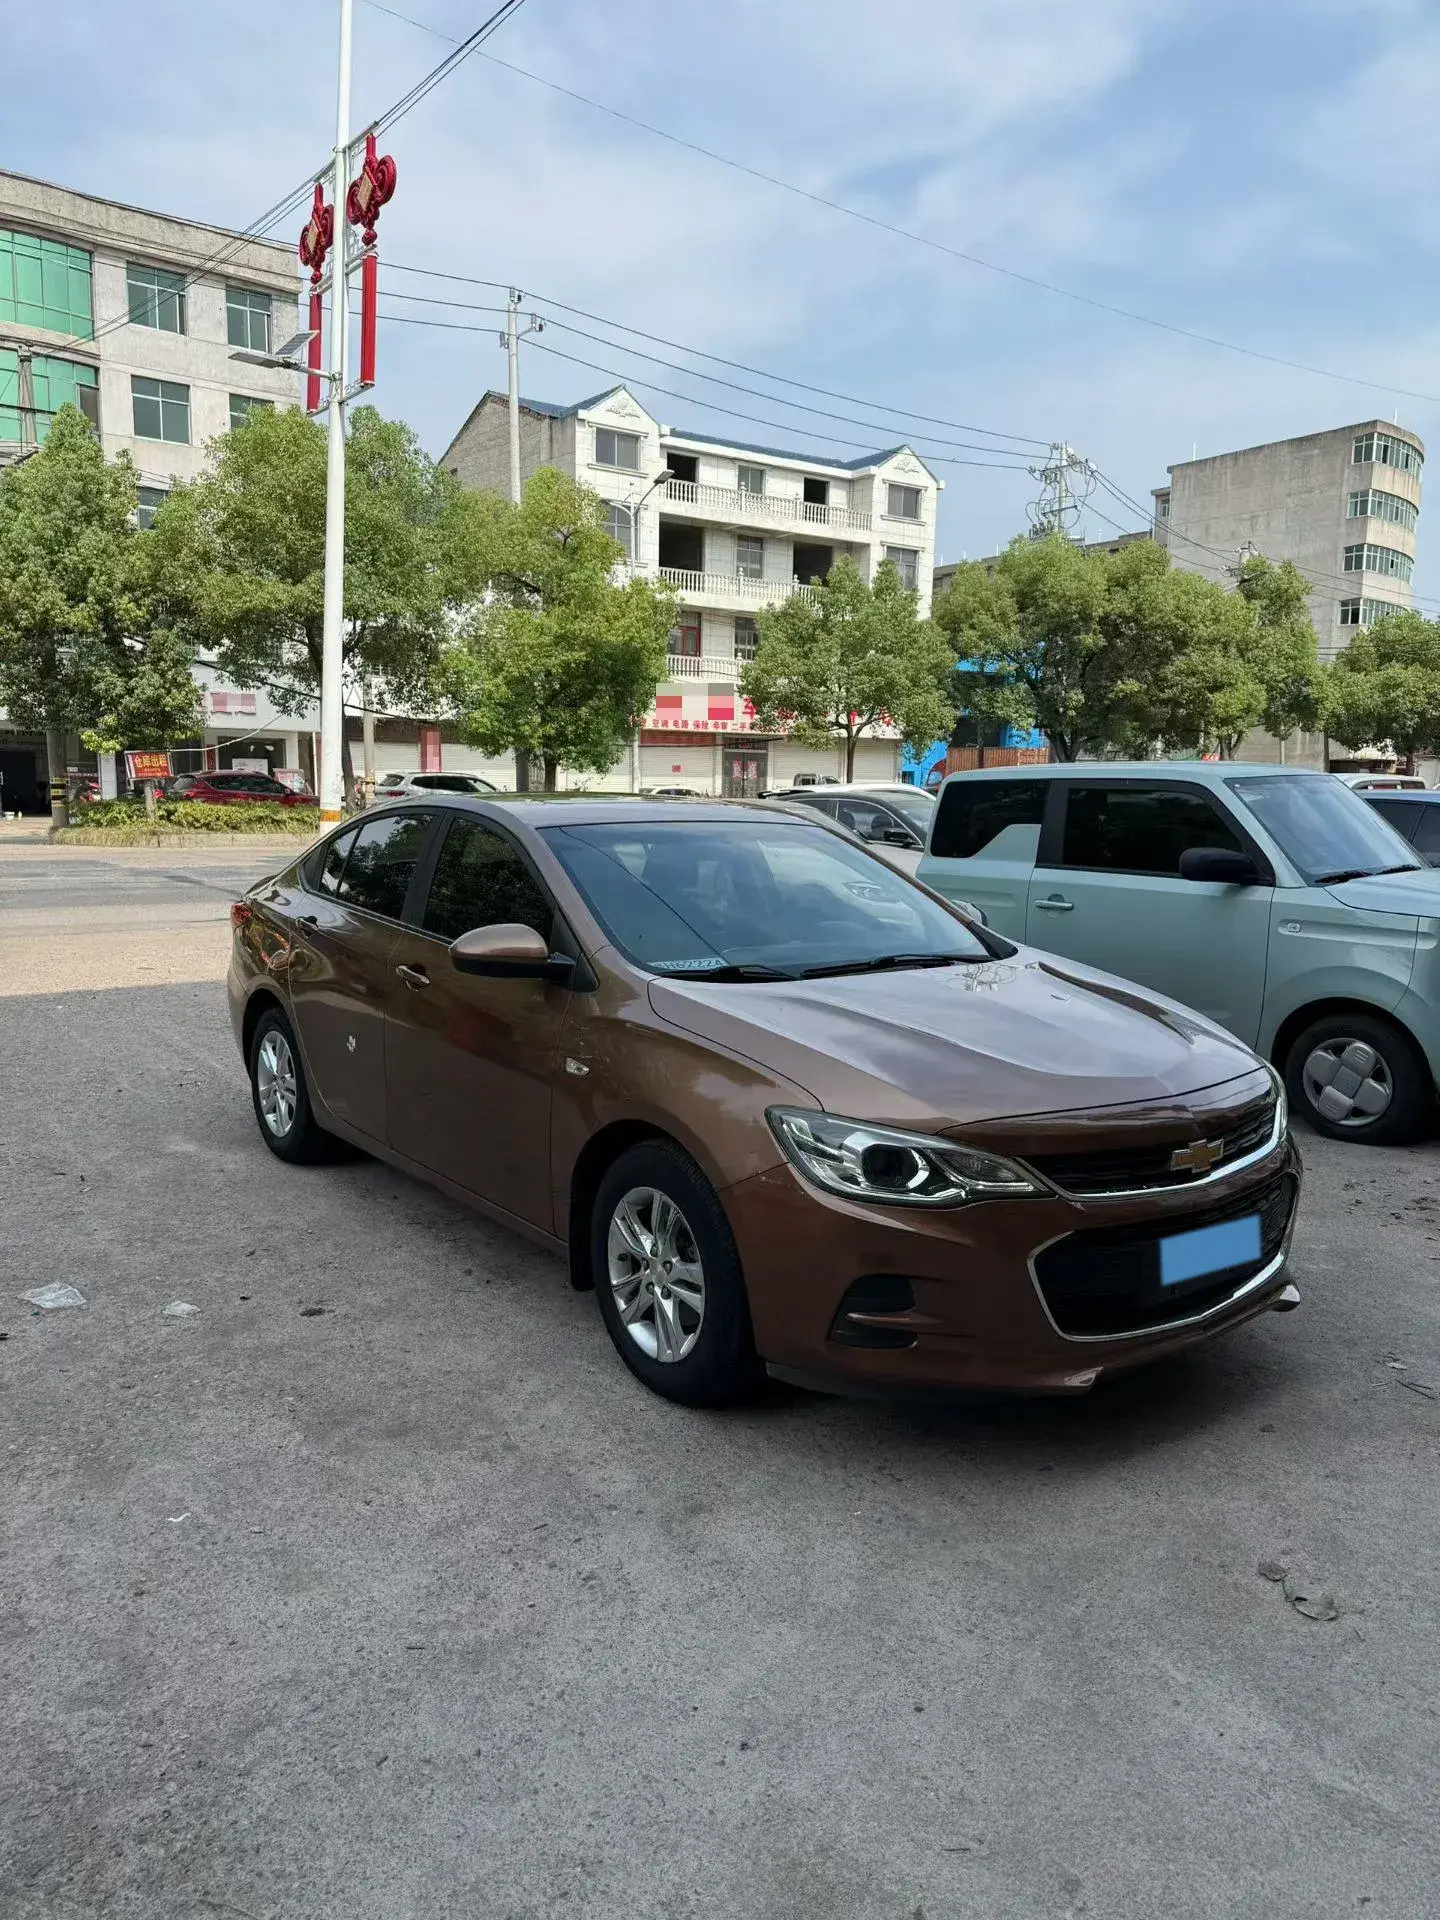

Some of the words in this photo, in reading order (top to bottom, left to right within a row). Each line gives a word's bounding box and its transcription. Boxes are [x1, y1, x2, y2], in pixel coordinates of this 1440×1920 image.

[652, 719, 669, 728] 空调
[673, 719, 689, 729] 电路
[693, 720, 709, 730] 保险
[134, 754, 168, 768] 仓库出租
